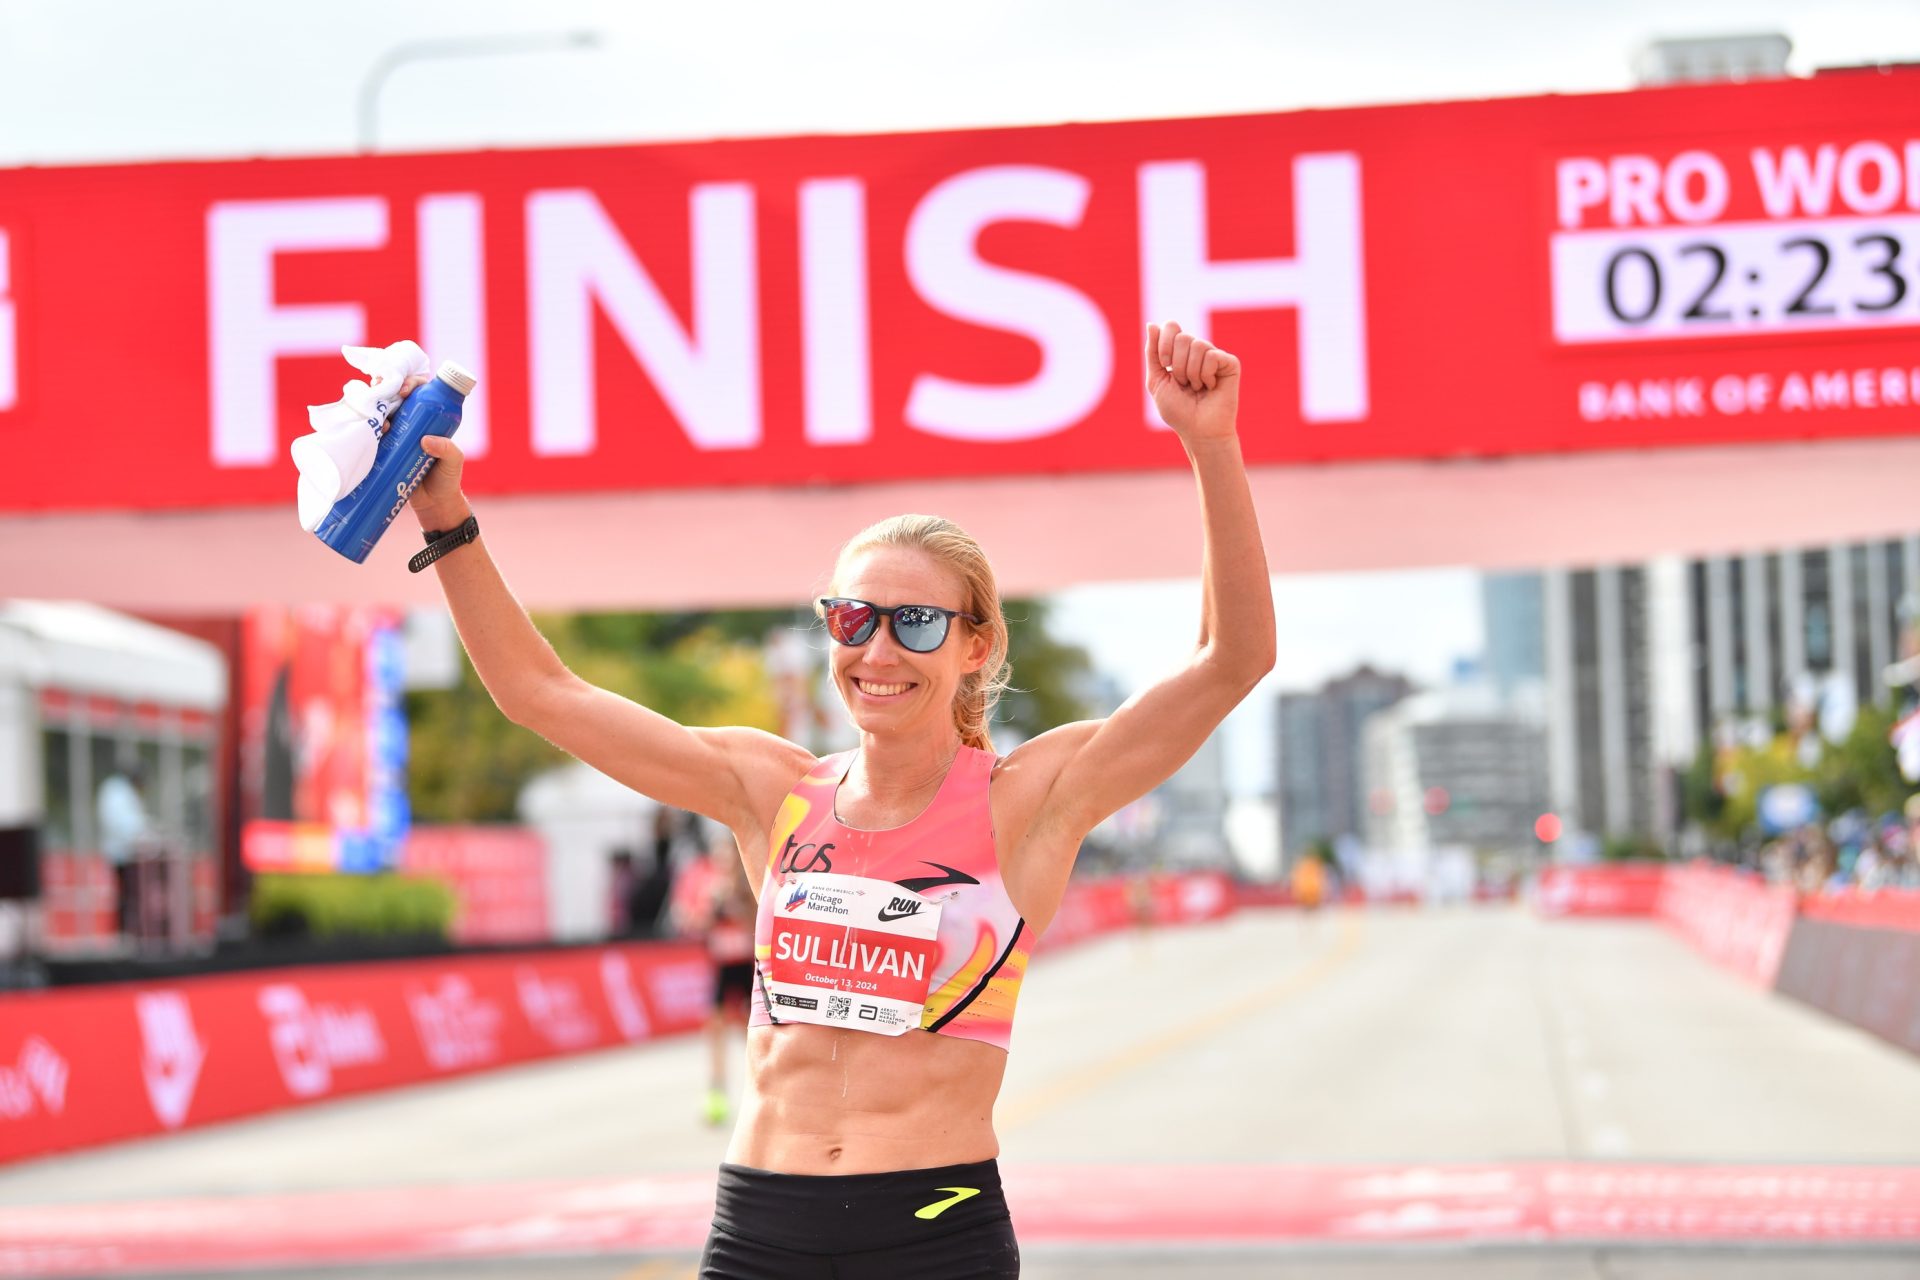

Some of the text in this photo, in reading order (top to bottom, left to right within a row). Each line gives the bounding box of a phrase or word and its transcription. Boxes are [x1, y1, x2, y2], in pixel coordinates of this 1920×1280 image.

[1556, 150, 1729, 230] PRO
[206, 152, 1369, 468] FINISH
[1578, 379, 1705, 422] BANK
[1711, 374, 1773, 416] OF
[779, 833, 836, 874] tcs
[807, 902, 849, 915] Marathon
[810, 892, 842, 904] Chicago
[887, 896, 922, 914] RUN
[776, 932, 925, 981] SULLIVAN
[805, 972, 877, 991] October 13, 2024
